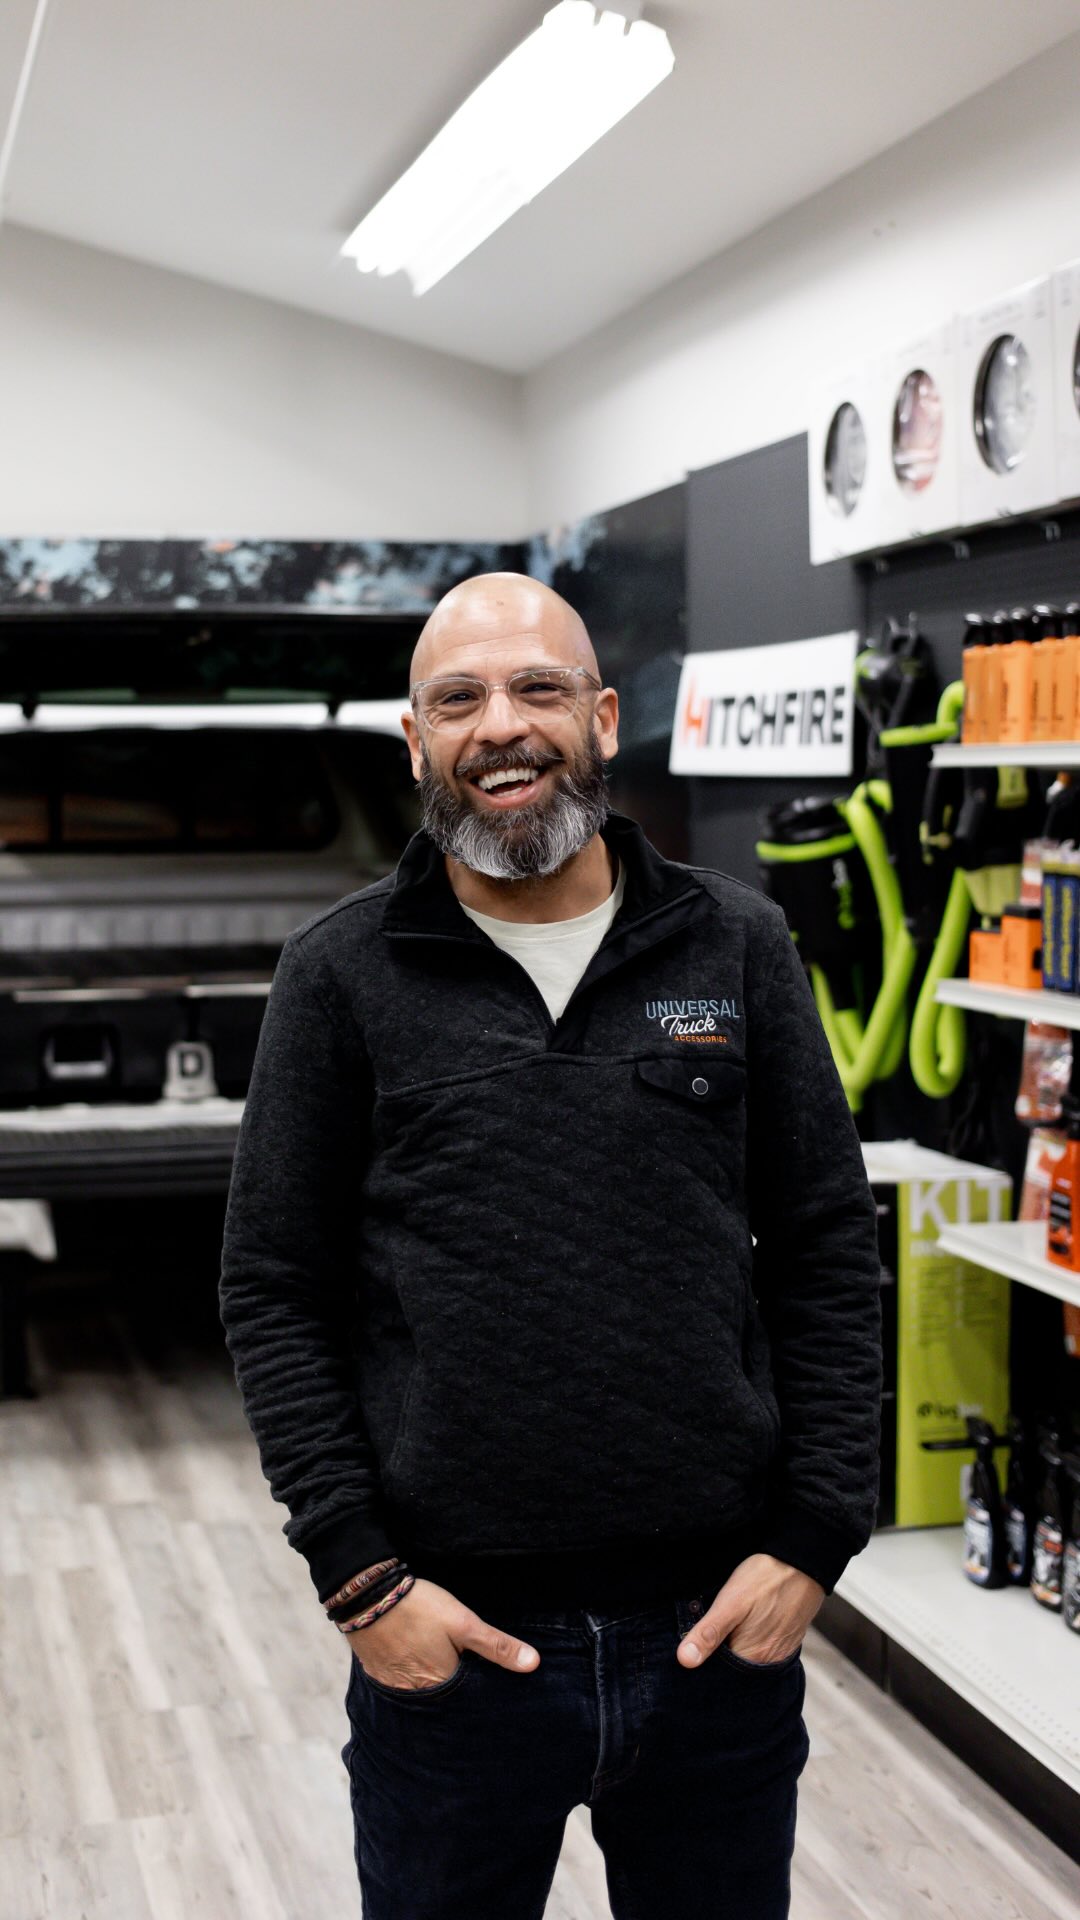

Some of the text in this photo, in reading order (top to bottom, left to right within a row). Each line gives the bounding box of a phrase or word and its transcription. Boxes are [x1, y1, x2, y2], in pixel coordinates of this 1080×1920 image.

[682, 674, 846, 747] HITCHFIRE
[645, 999, 741, 1020] UNIVERSAL
[660, 1011, 717, 1036] Truck
[674, 1035, 727, 1043] ACCESSORIES
[909, 1179, 1010, 1233] KIT
